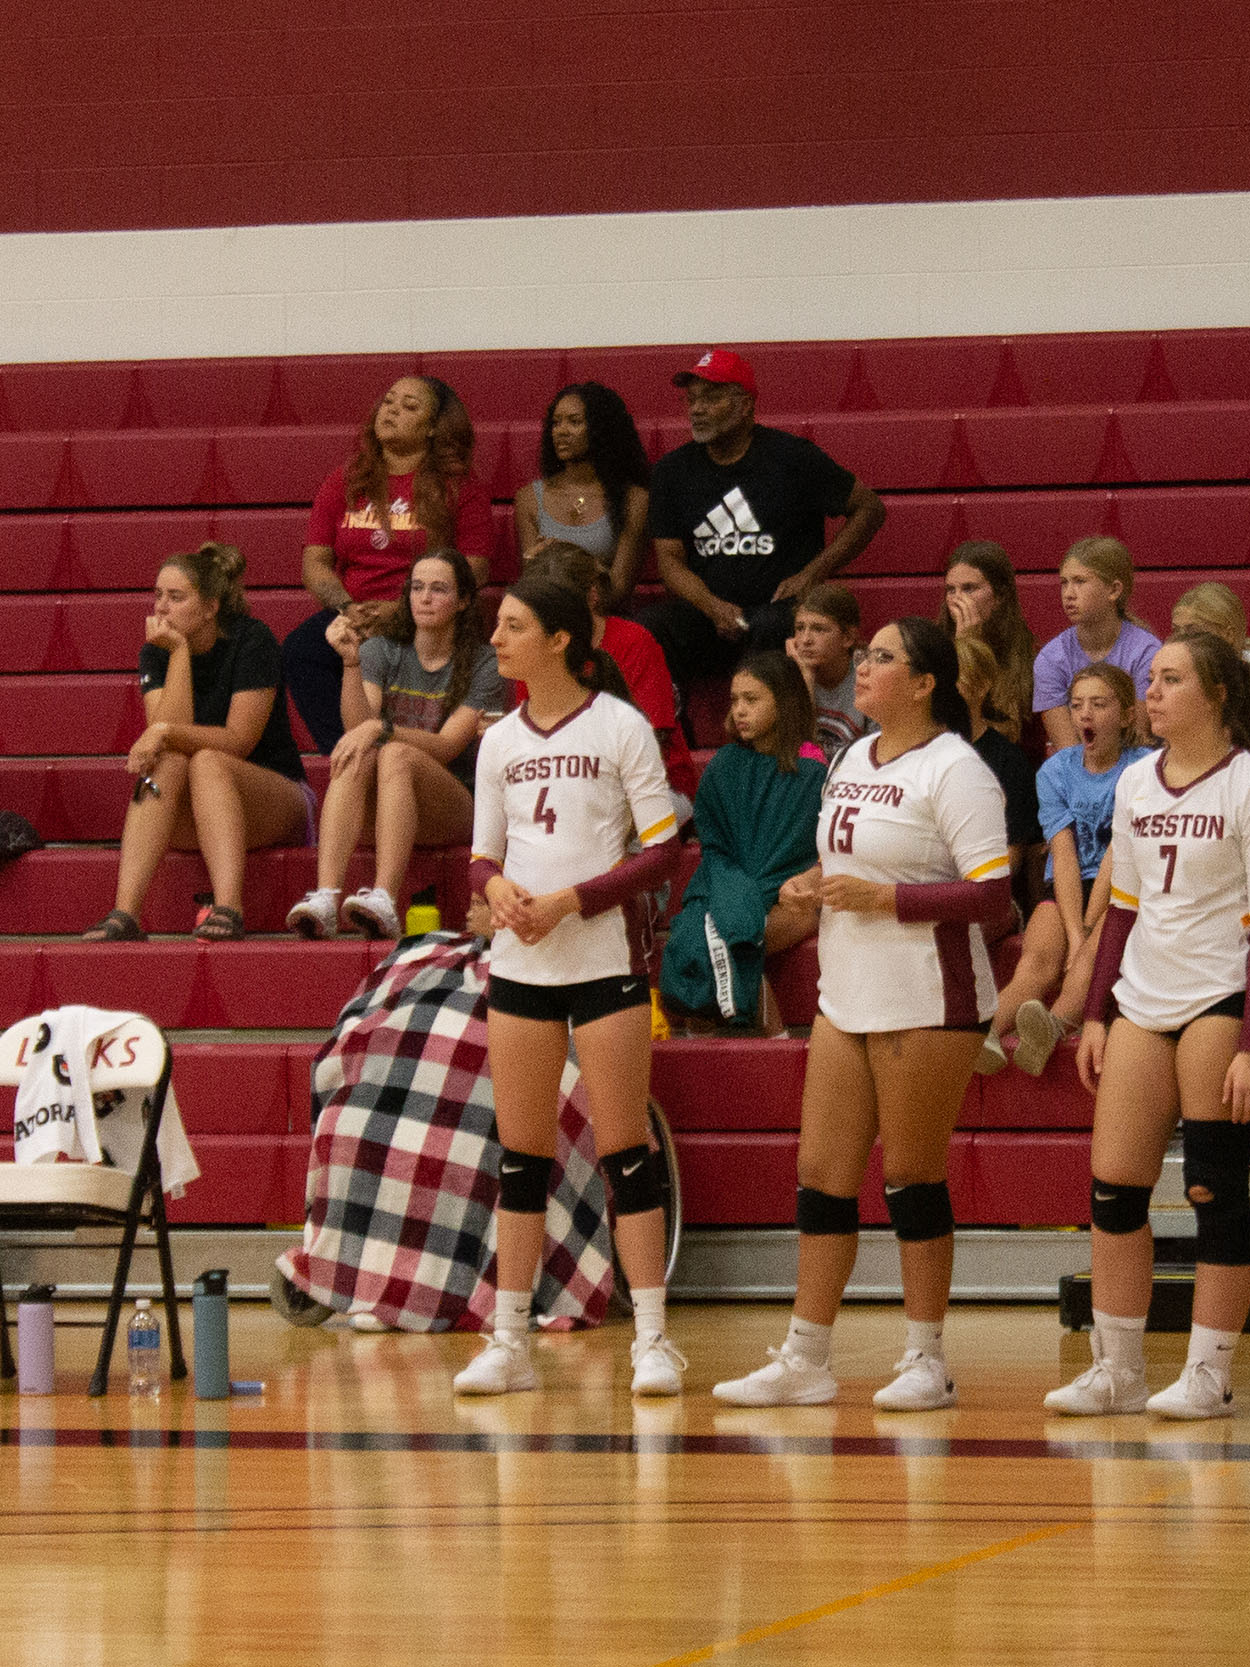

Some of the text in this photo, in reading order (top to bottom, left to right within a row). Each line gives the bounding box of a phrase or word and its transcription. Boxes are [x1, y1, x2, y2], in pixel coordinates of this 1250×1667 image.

[694, 531, 775, 557] addas
[505, 755, 600, 785] HESSTON
[533, 786, 557, 834] 4
[1130, 814, 1225, 840] HESSTON
[828, 805, 860, 854] 15
[1159, 844, 1178, 894] 7
[16, 1036, 140, 1069] LKS
[15, 1103, 76, 1142] ATORA
